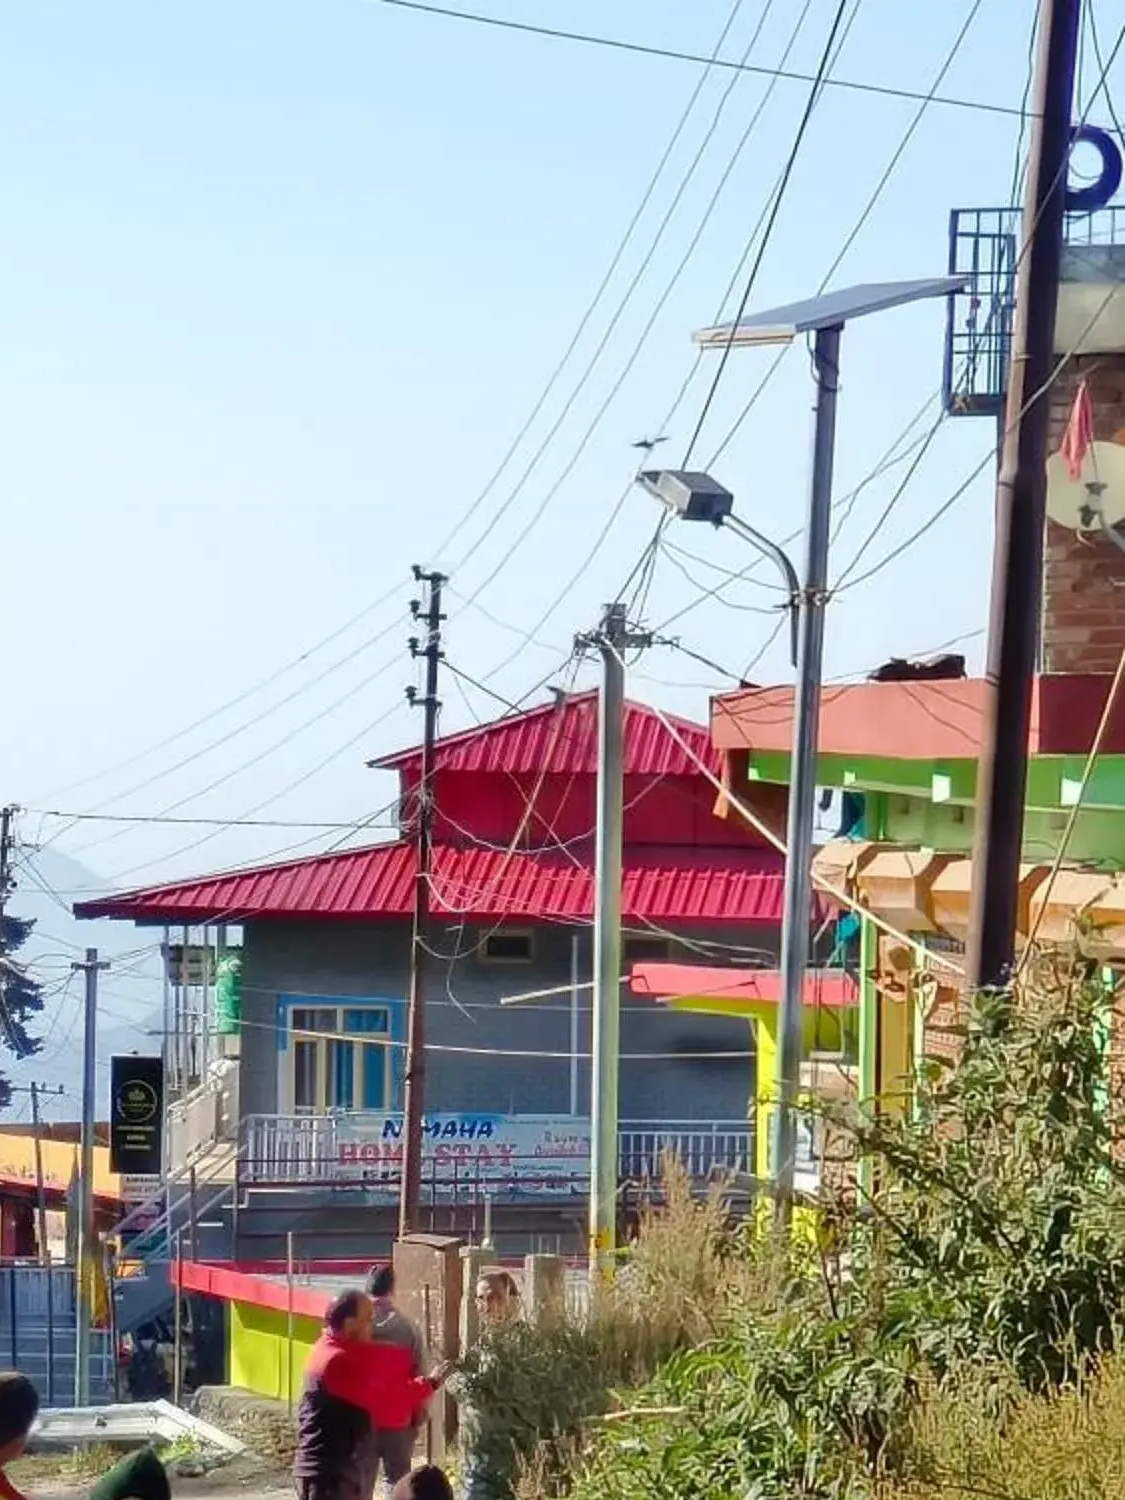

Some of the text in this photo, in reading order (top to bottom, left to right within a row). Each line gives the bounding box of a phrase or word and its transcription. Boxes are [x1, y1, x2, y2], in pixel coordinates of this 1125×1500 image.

[382, 1119, 495, 1139] NMAHA
[338, 1143, 405, 1166] HOM
[434, 1143, 517, 1167] STAY
